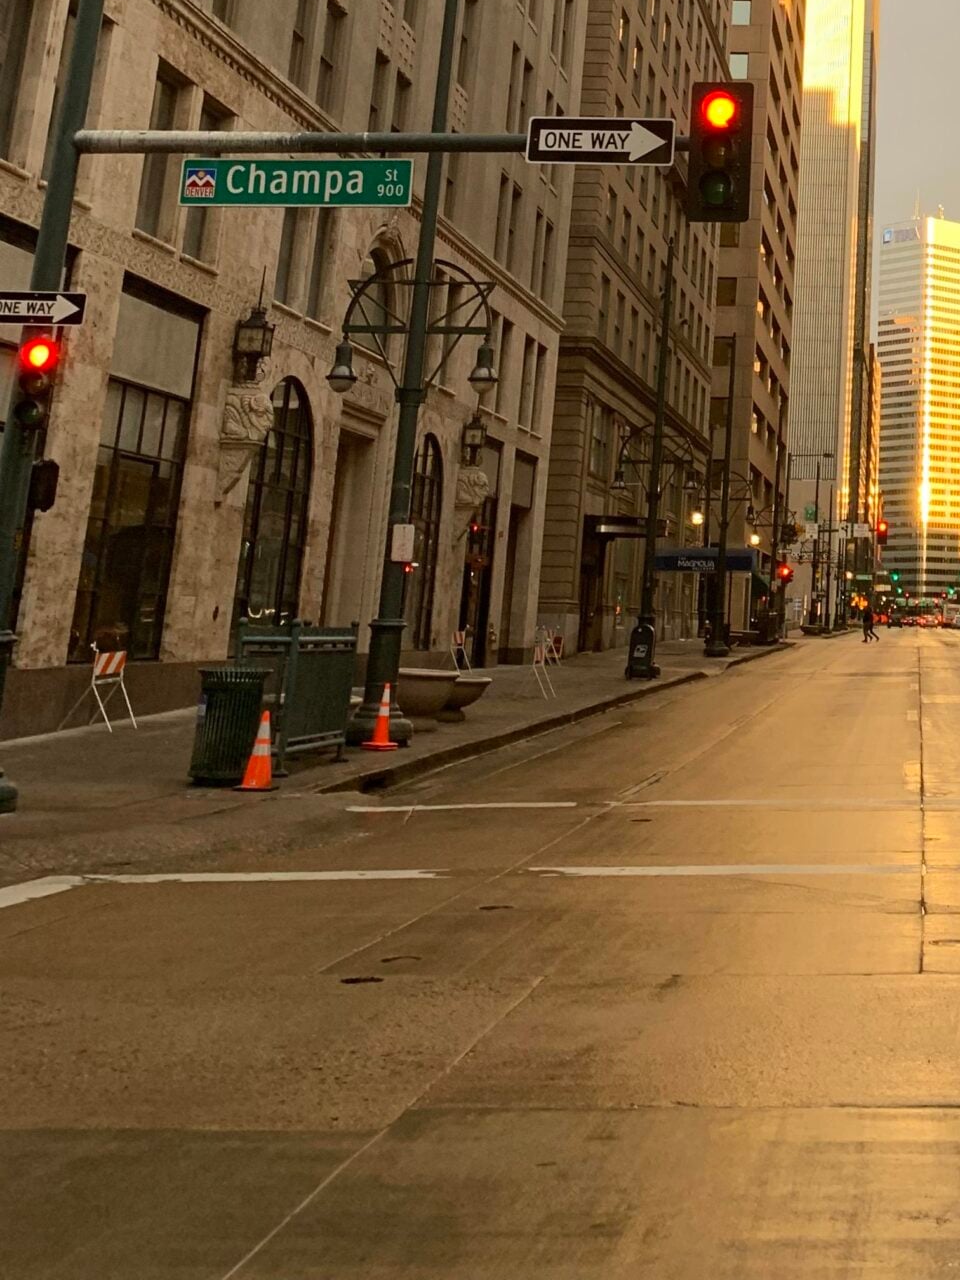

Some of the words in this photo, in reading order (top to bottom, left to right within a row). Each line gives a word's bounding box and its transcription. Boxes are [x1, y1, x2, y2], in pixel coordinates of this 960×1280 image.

[544, 131, 583, 148] ONE
[591, 133, 630, 149] WAY
[226, 163, 364, 202] Champa
[385, 169, 397, 181] St
[185, 187, 214, 197] DENVER
[377, 184, 404, 197] 900
[26, 302, 55, 314] WAY
